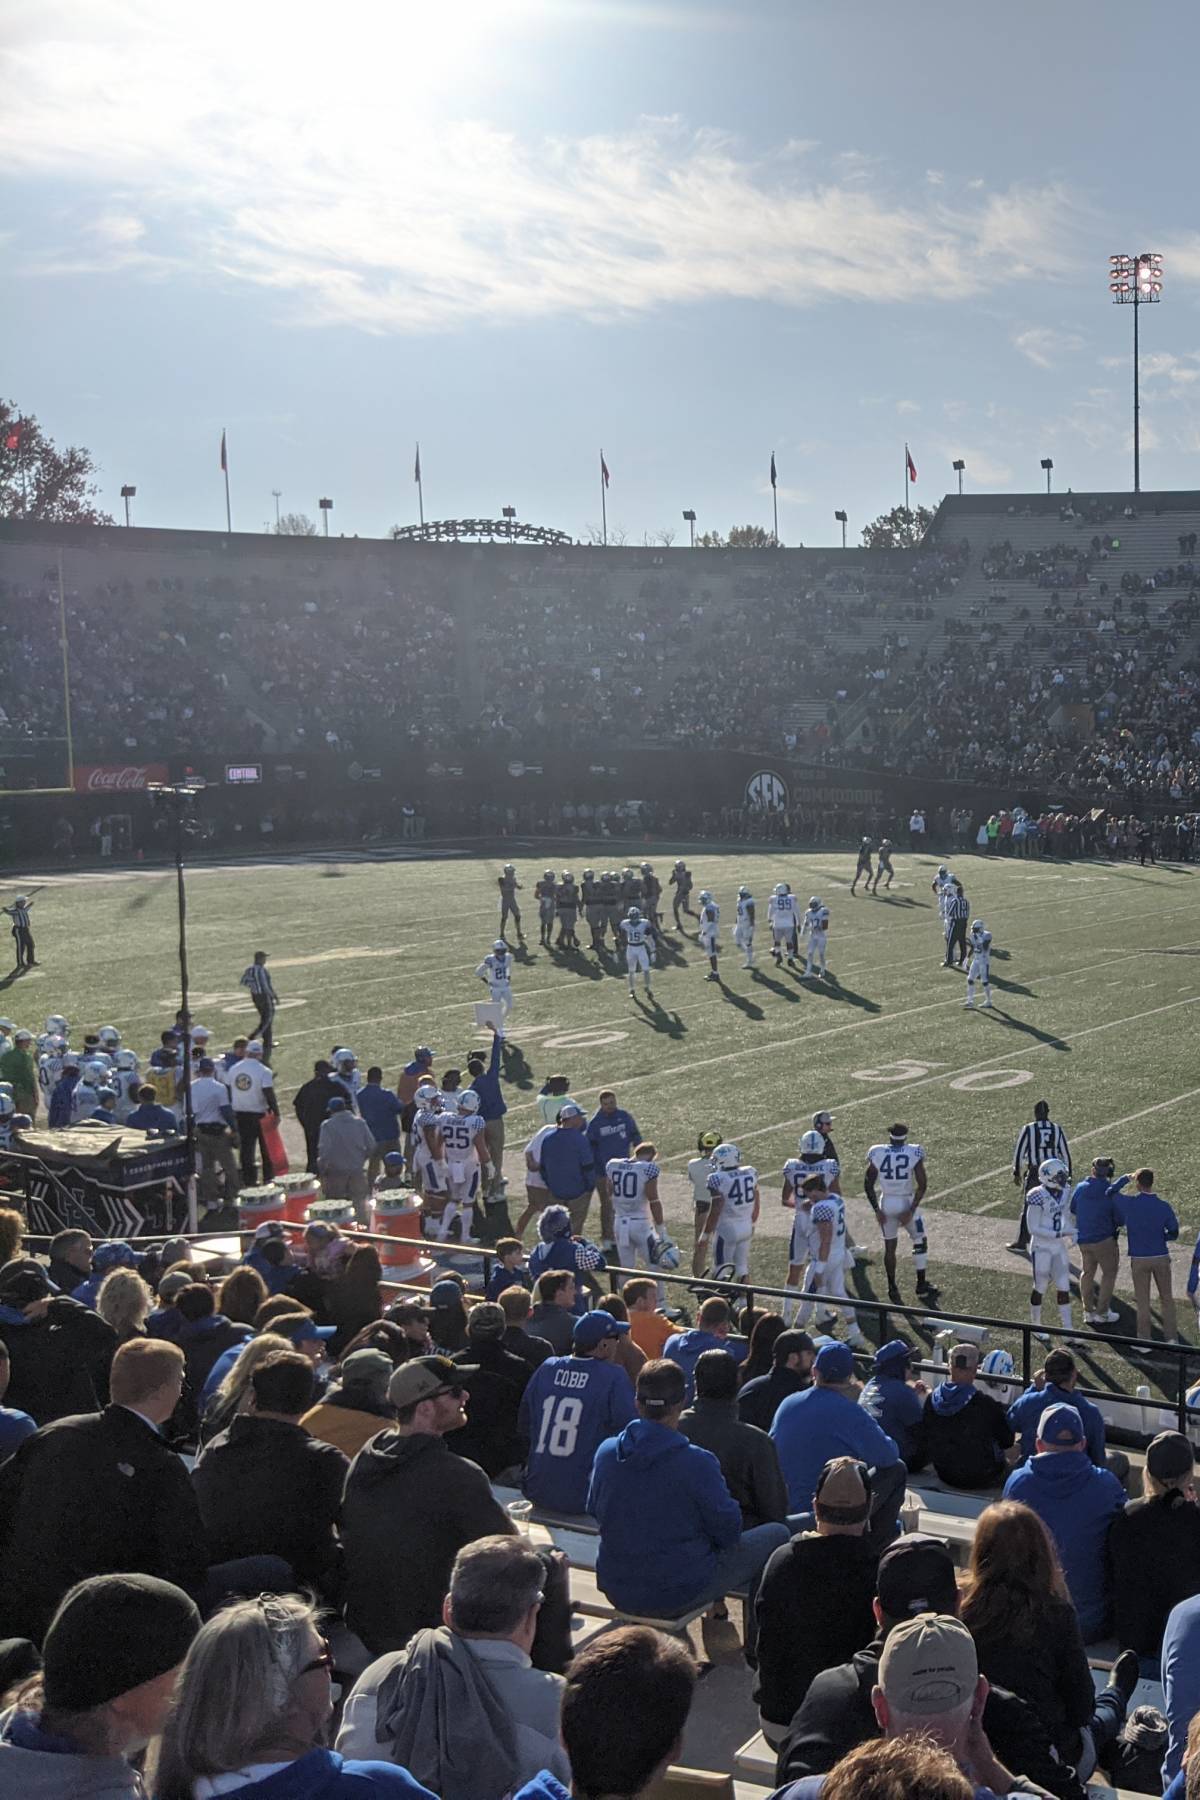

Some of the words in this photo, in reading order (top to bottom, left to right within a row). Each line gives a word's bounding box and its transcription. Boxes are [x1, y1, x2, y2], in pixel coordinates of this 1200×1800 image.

[1041, 1129, 1052, 1147] F
[879, 1154, 910, 1180] 42
[611, 1171, 638, 1198] 80
[727, 1176, 756, 1206] 46
[553, 1368, 590, 1389] COBB
[535, 1395, 583, 1457] 18
